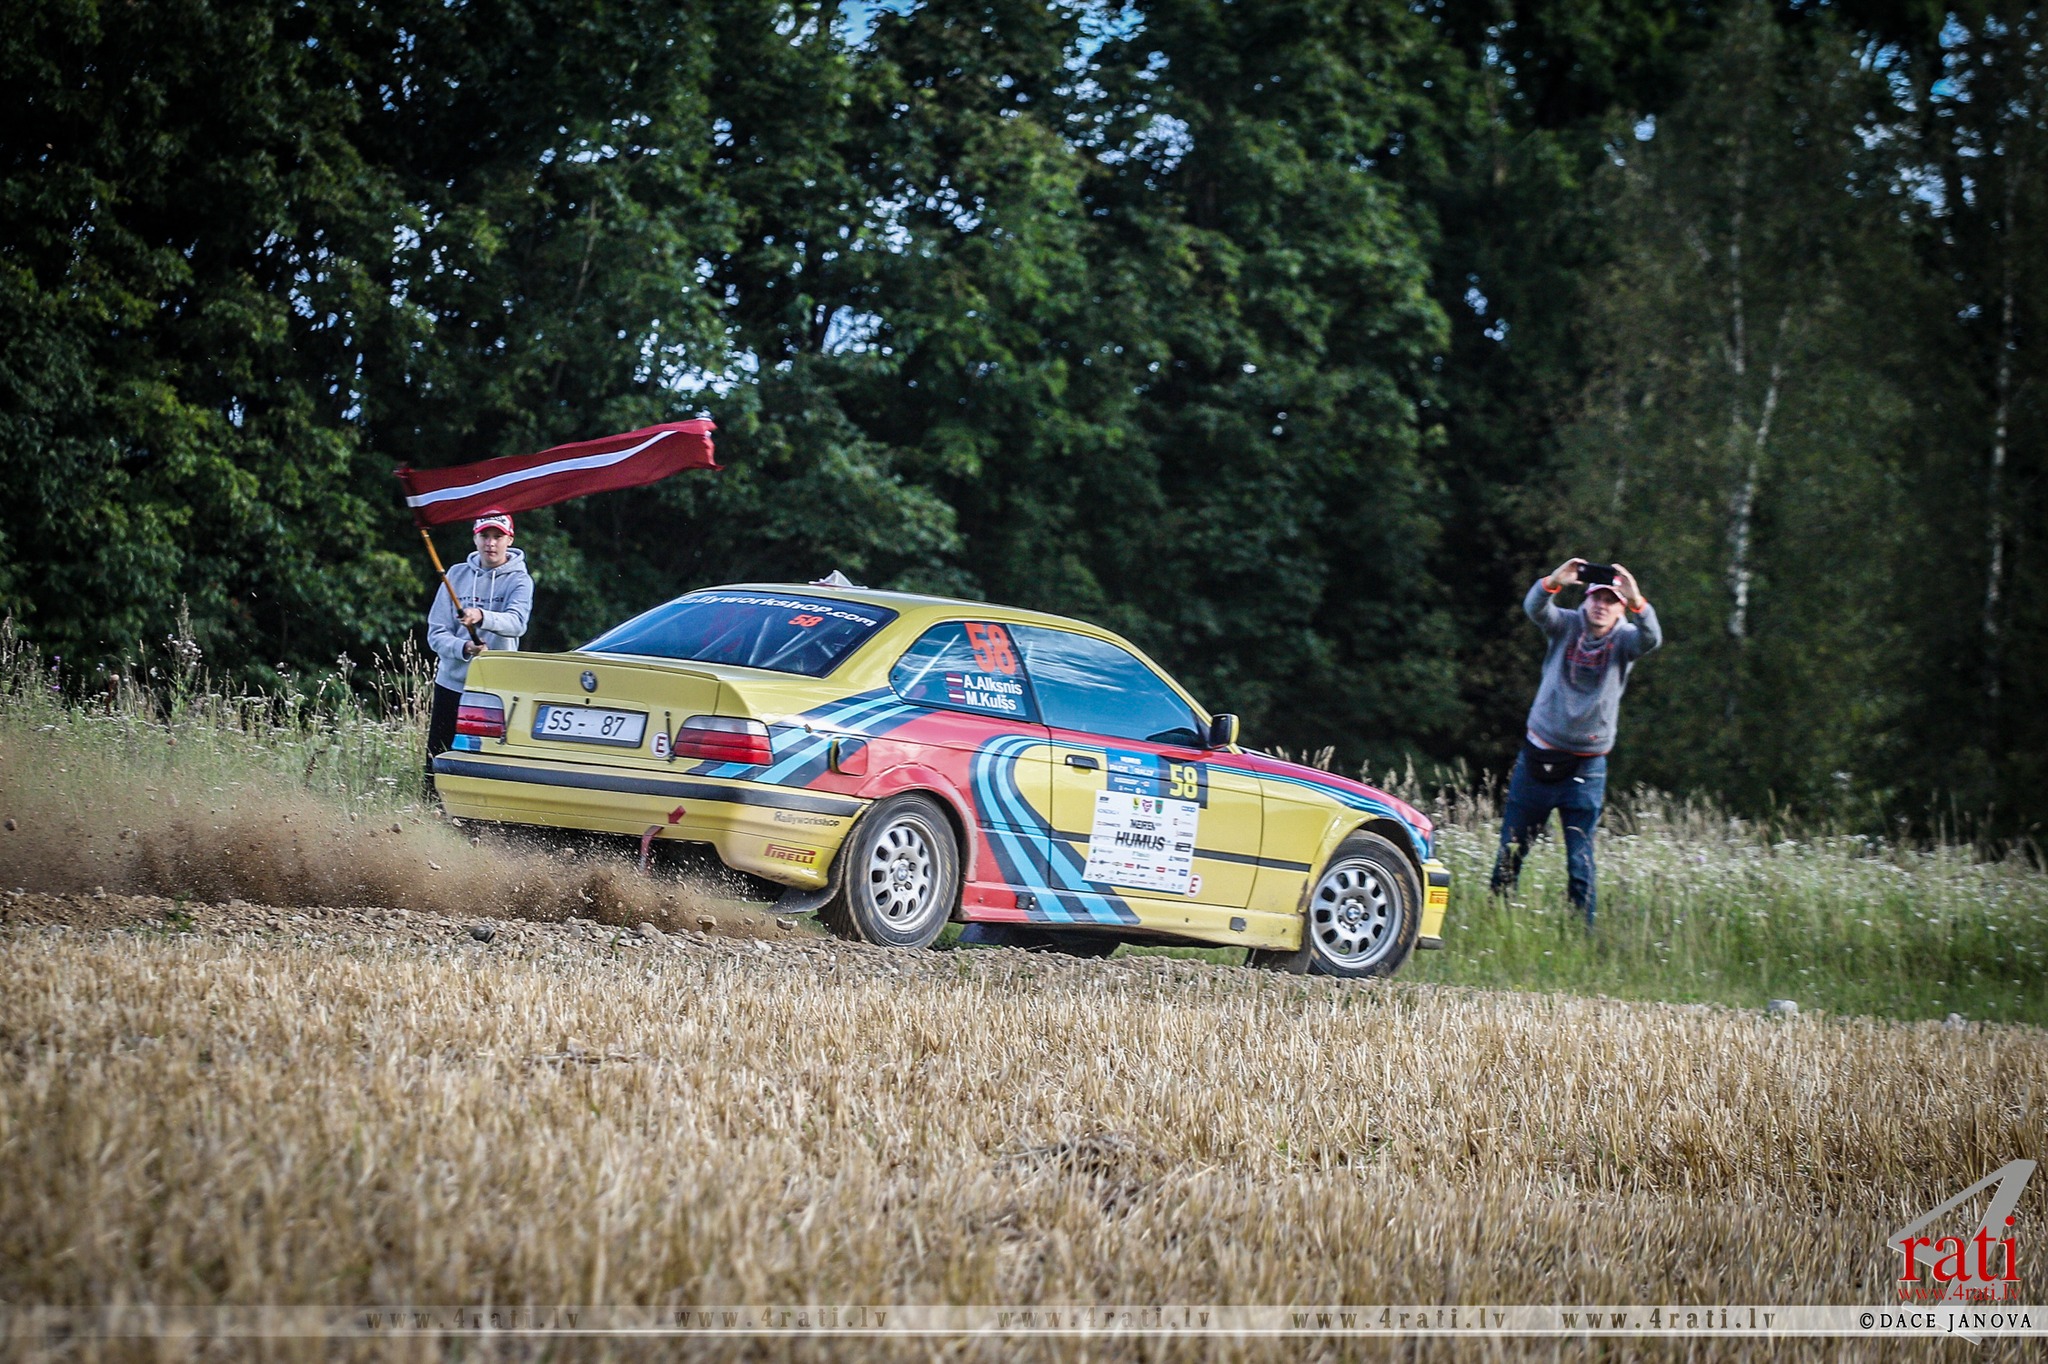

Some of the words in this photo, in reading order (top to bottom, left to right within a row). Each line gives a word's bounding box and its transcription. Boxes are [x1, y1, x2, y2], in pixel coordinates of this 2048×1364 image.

[788, 614, 823, 627] 58
[964, 622, 1016, 675] 58
[963, 674, 1023, 695] A.Alksnis
[965, 691, 1017, 711] M.Kulšs
[601, 715, 626, 737] 87
[655, 735, 667, 753] E
[1169, 763, 1198, 799] 58
[1115, 831, 1166, 851] HUMUS
[764, 843, 817, 864] PIRELLI
[1188, 877, 1199, 893] E
